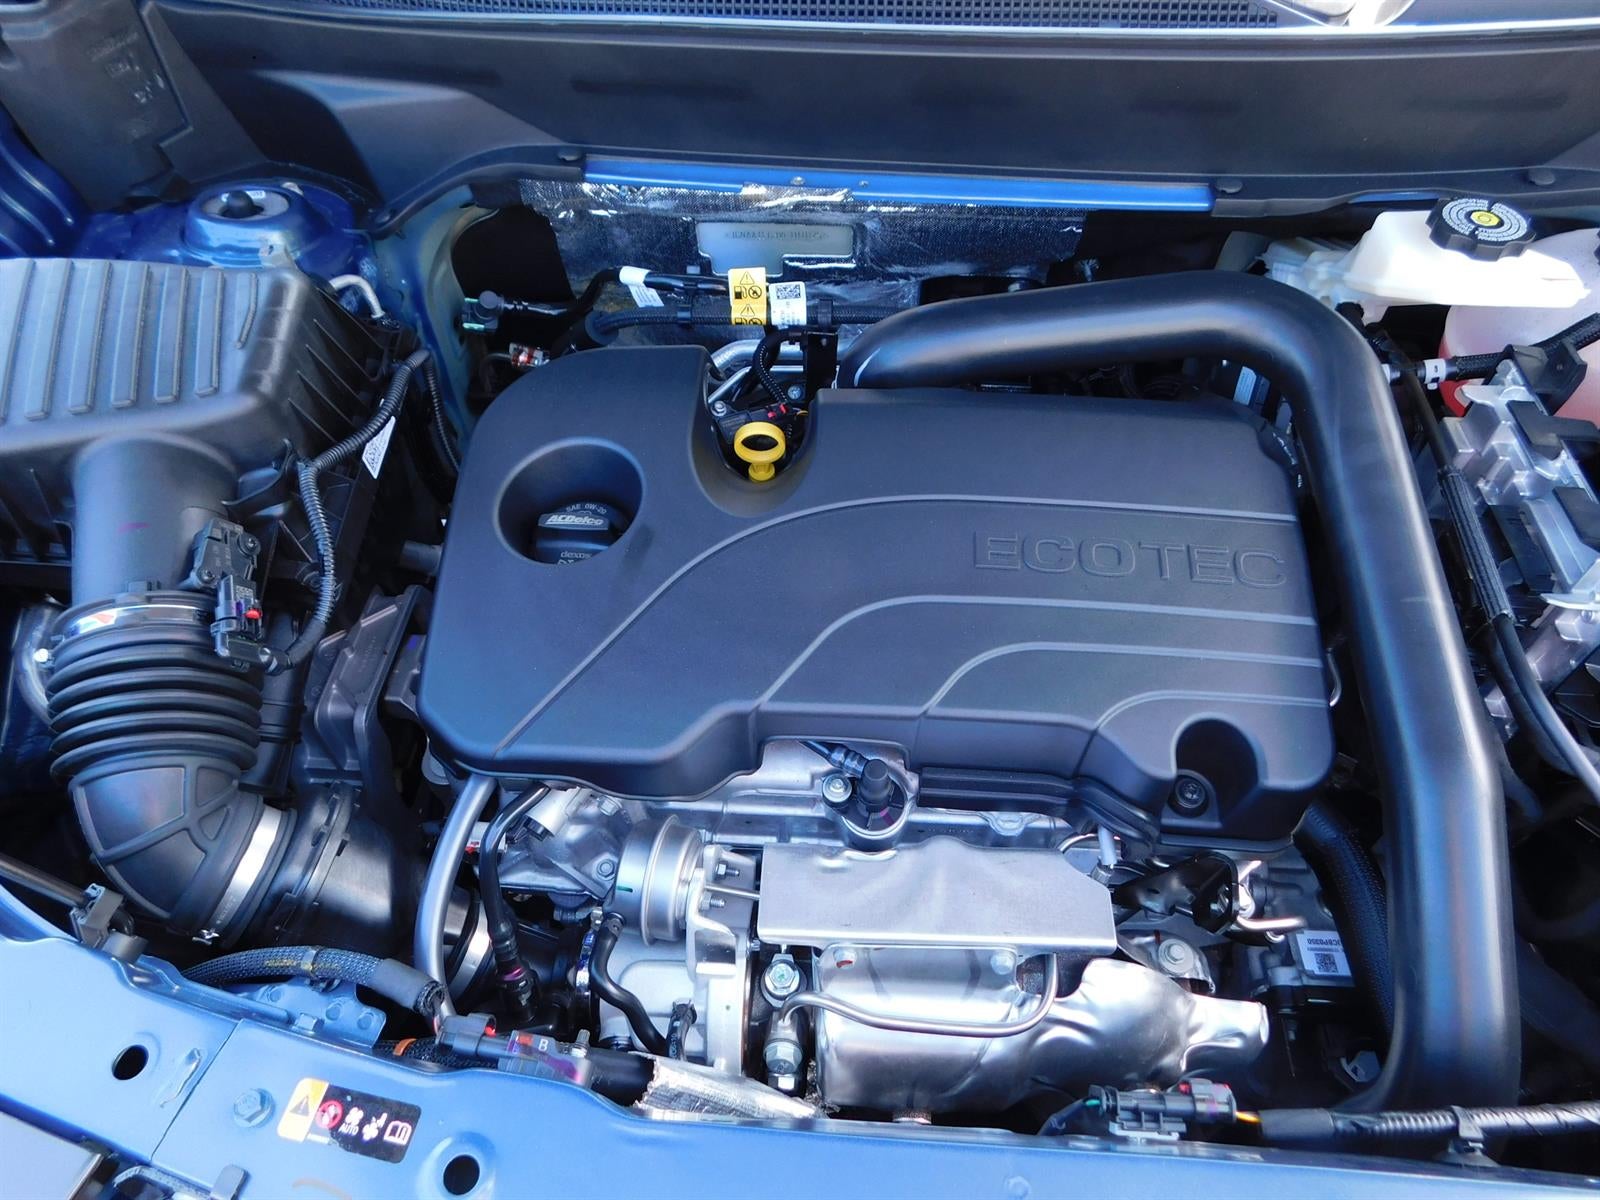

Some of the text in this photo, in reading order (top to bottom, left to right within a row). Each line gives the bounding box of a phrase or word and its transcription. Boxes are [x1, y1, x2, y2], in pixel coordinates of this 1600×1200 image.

[566, 503, 607, 514] SAE 0W-20
[546, 515, 604, 525] ACDelco
[973, 530, 1287, 589] ECOTEC
[538, 1038, 549, 1052] B
[338, 1122, 359, 1137] AUTO
